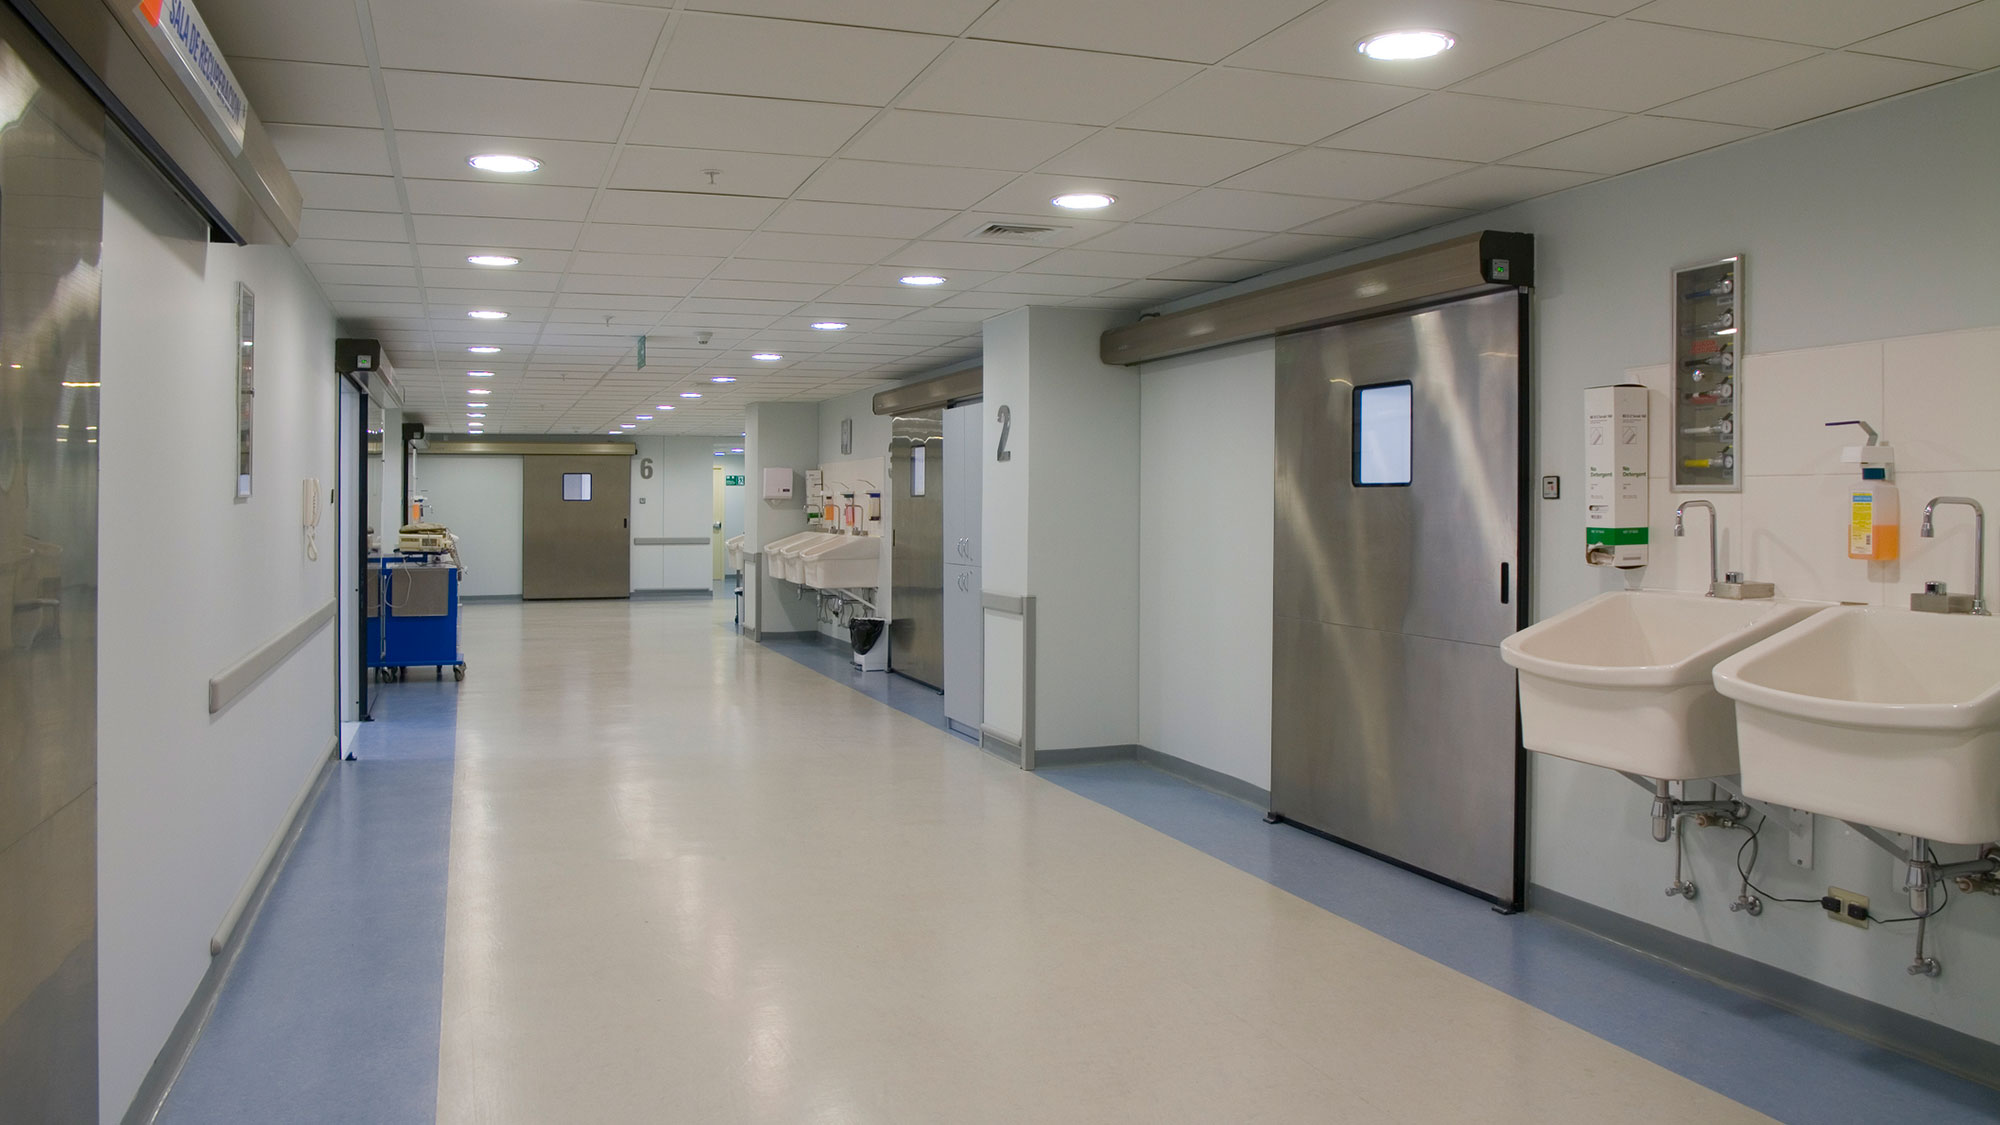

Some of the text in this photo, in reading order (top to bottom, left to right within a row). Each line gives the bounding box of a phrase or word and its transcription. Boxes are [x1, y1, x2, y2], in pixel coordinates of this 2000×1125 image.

[169, 0, 189, 47] SALA
[188, 23, 201, 62] DE
[996, 404, 1011, 462] 2
[640, 457, 653, 480] 6
